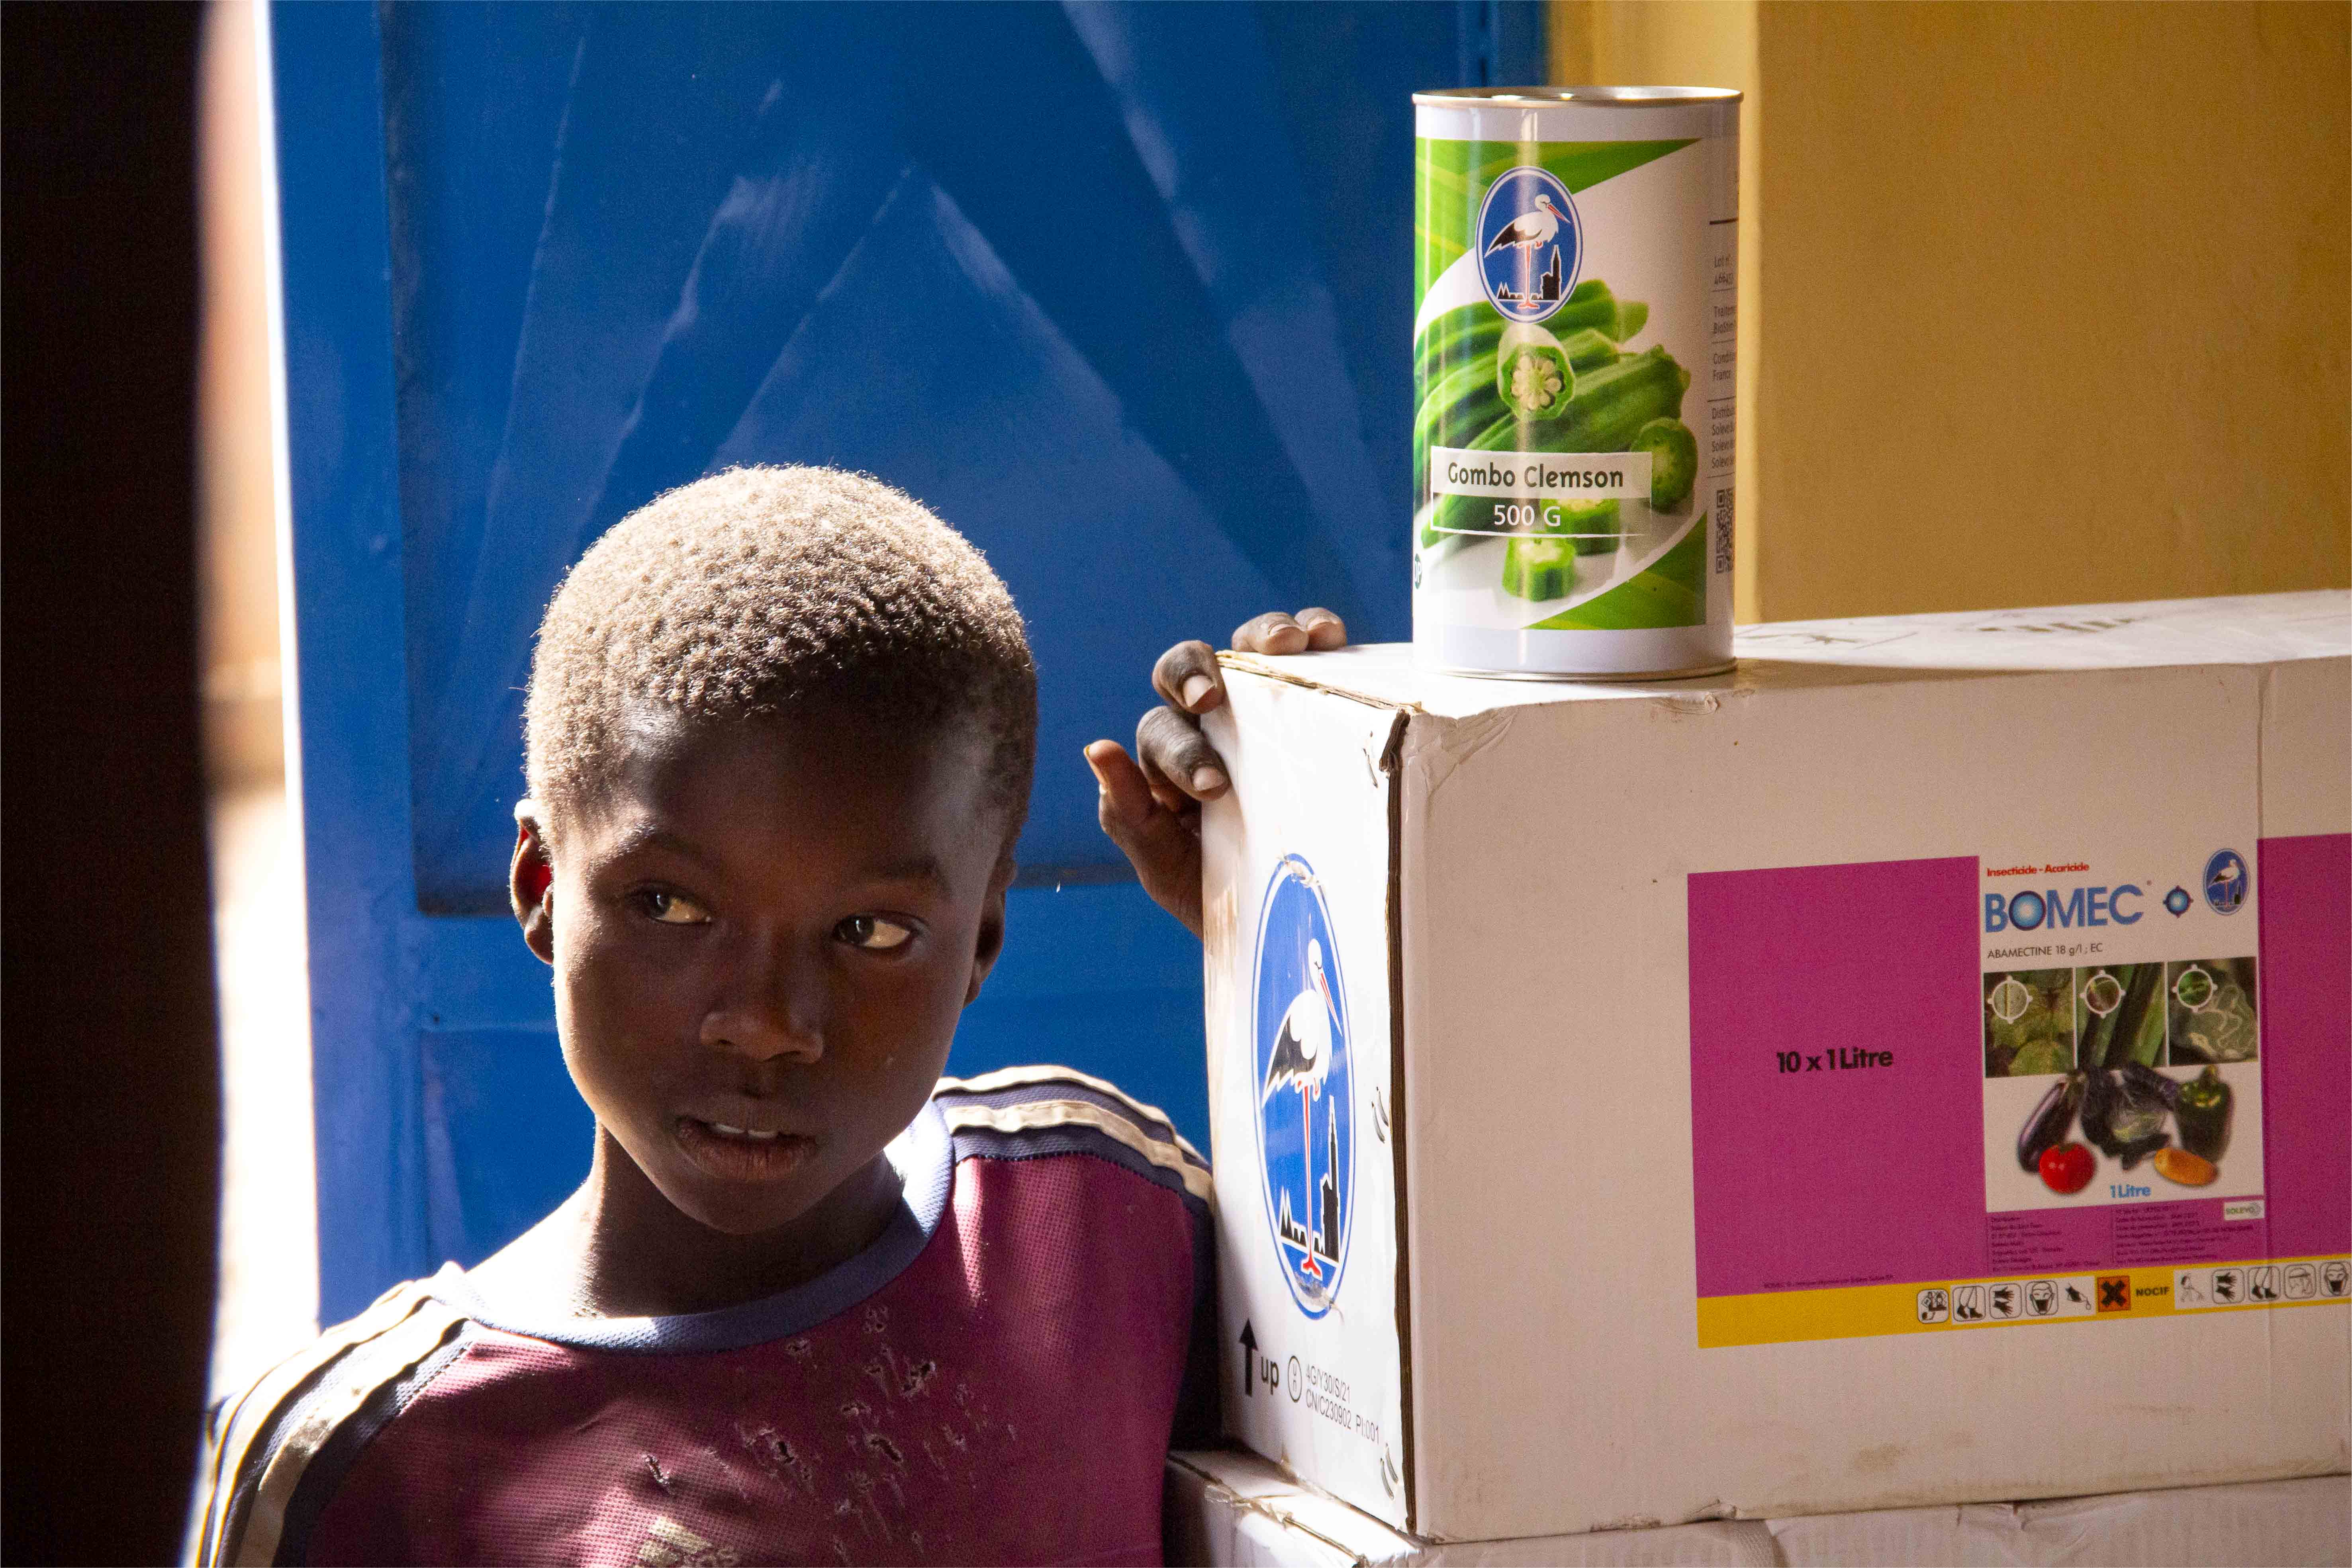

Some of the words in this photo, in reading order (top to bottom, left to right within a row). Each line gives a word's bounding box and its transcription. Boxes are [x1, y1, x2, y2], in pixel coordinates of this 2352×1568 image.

[1448, 462, 1516, 487] Gombo
[1524, 464, 1623, 488] Clemson
[1494, 504, 1535, 526] 500
[1543, 506, 1561, 526] G
[1987, 864, 2037, 877] Insecticide
[2045, 862, 2090, 873] Acaricide
[1985, 884, 2144, 933] BOMEC
[1987, 945, 2052, 959] ABAMECTINE
[2056, 945, 2066, 954] 18
[2090, 943, 2103, 953] EC
[1776, 1051, 1801, 1073] 10
[1806, 1055, 1823, 1071] x
[1827, 1049, 1835, 1070] 1
[1840, 1047, 1893, 1069] Litre
[2109, 1185, 2116, 1198] 1
[2118, 1184, 2151, 1198] Litre
[2136, 1286, 2170, 1296] NOCIF
[1261, 1356, 1279, 1395] up
[1306, 1363, 1351, 1404] 4G/Y30/S/21
[1306, 1389, 1351, 1430] CN/C230902
